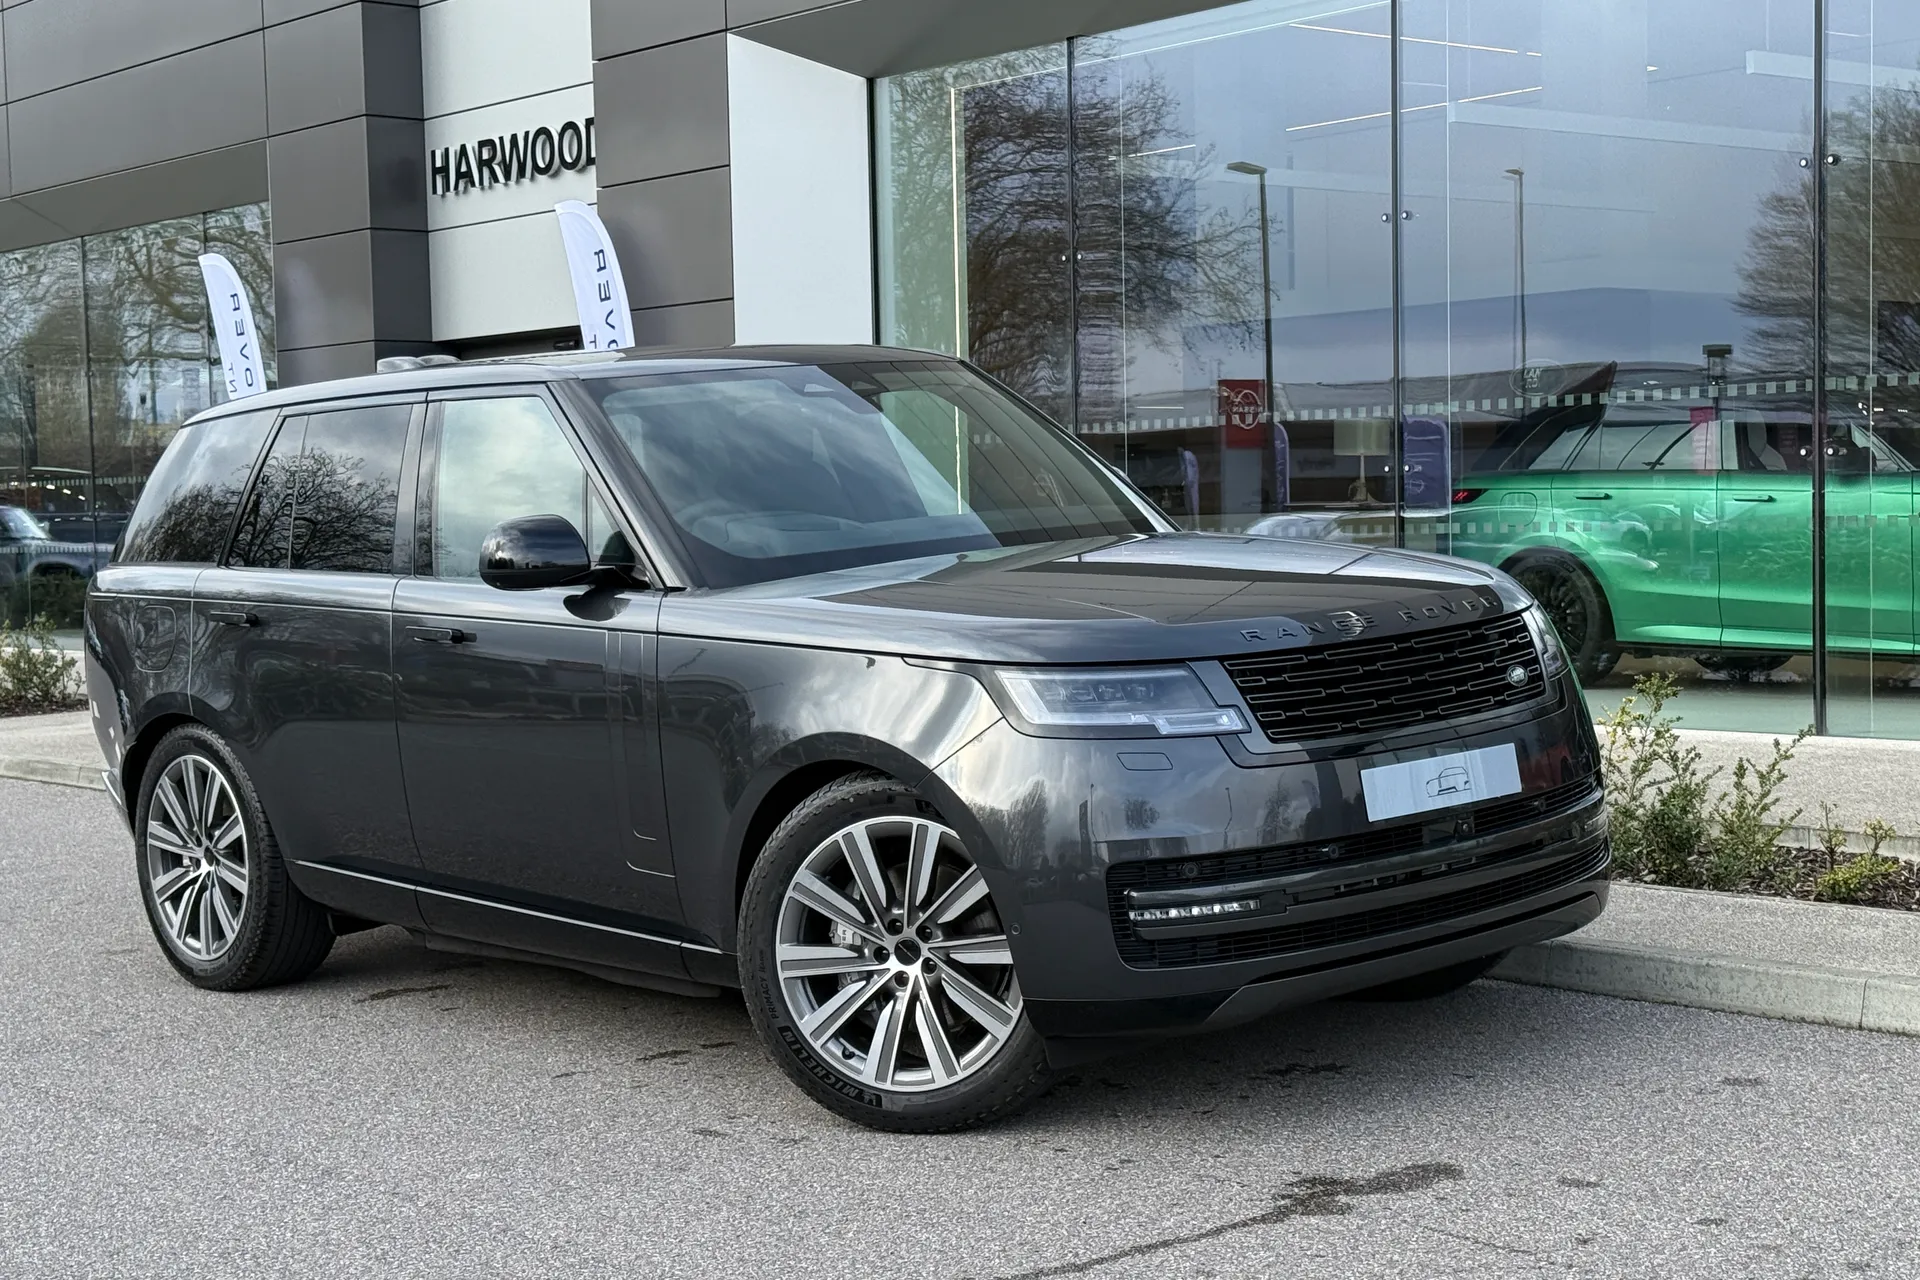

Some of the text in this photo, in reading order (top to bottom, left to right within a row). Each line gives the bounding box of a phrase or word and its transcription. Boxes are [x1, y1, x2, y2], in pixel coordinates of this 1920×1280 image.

[1240, 596, 1499, 642] RANGE ROVER
[782, 1031, 860, 1097] MICHELIN
